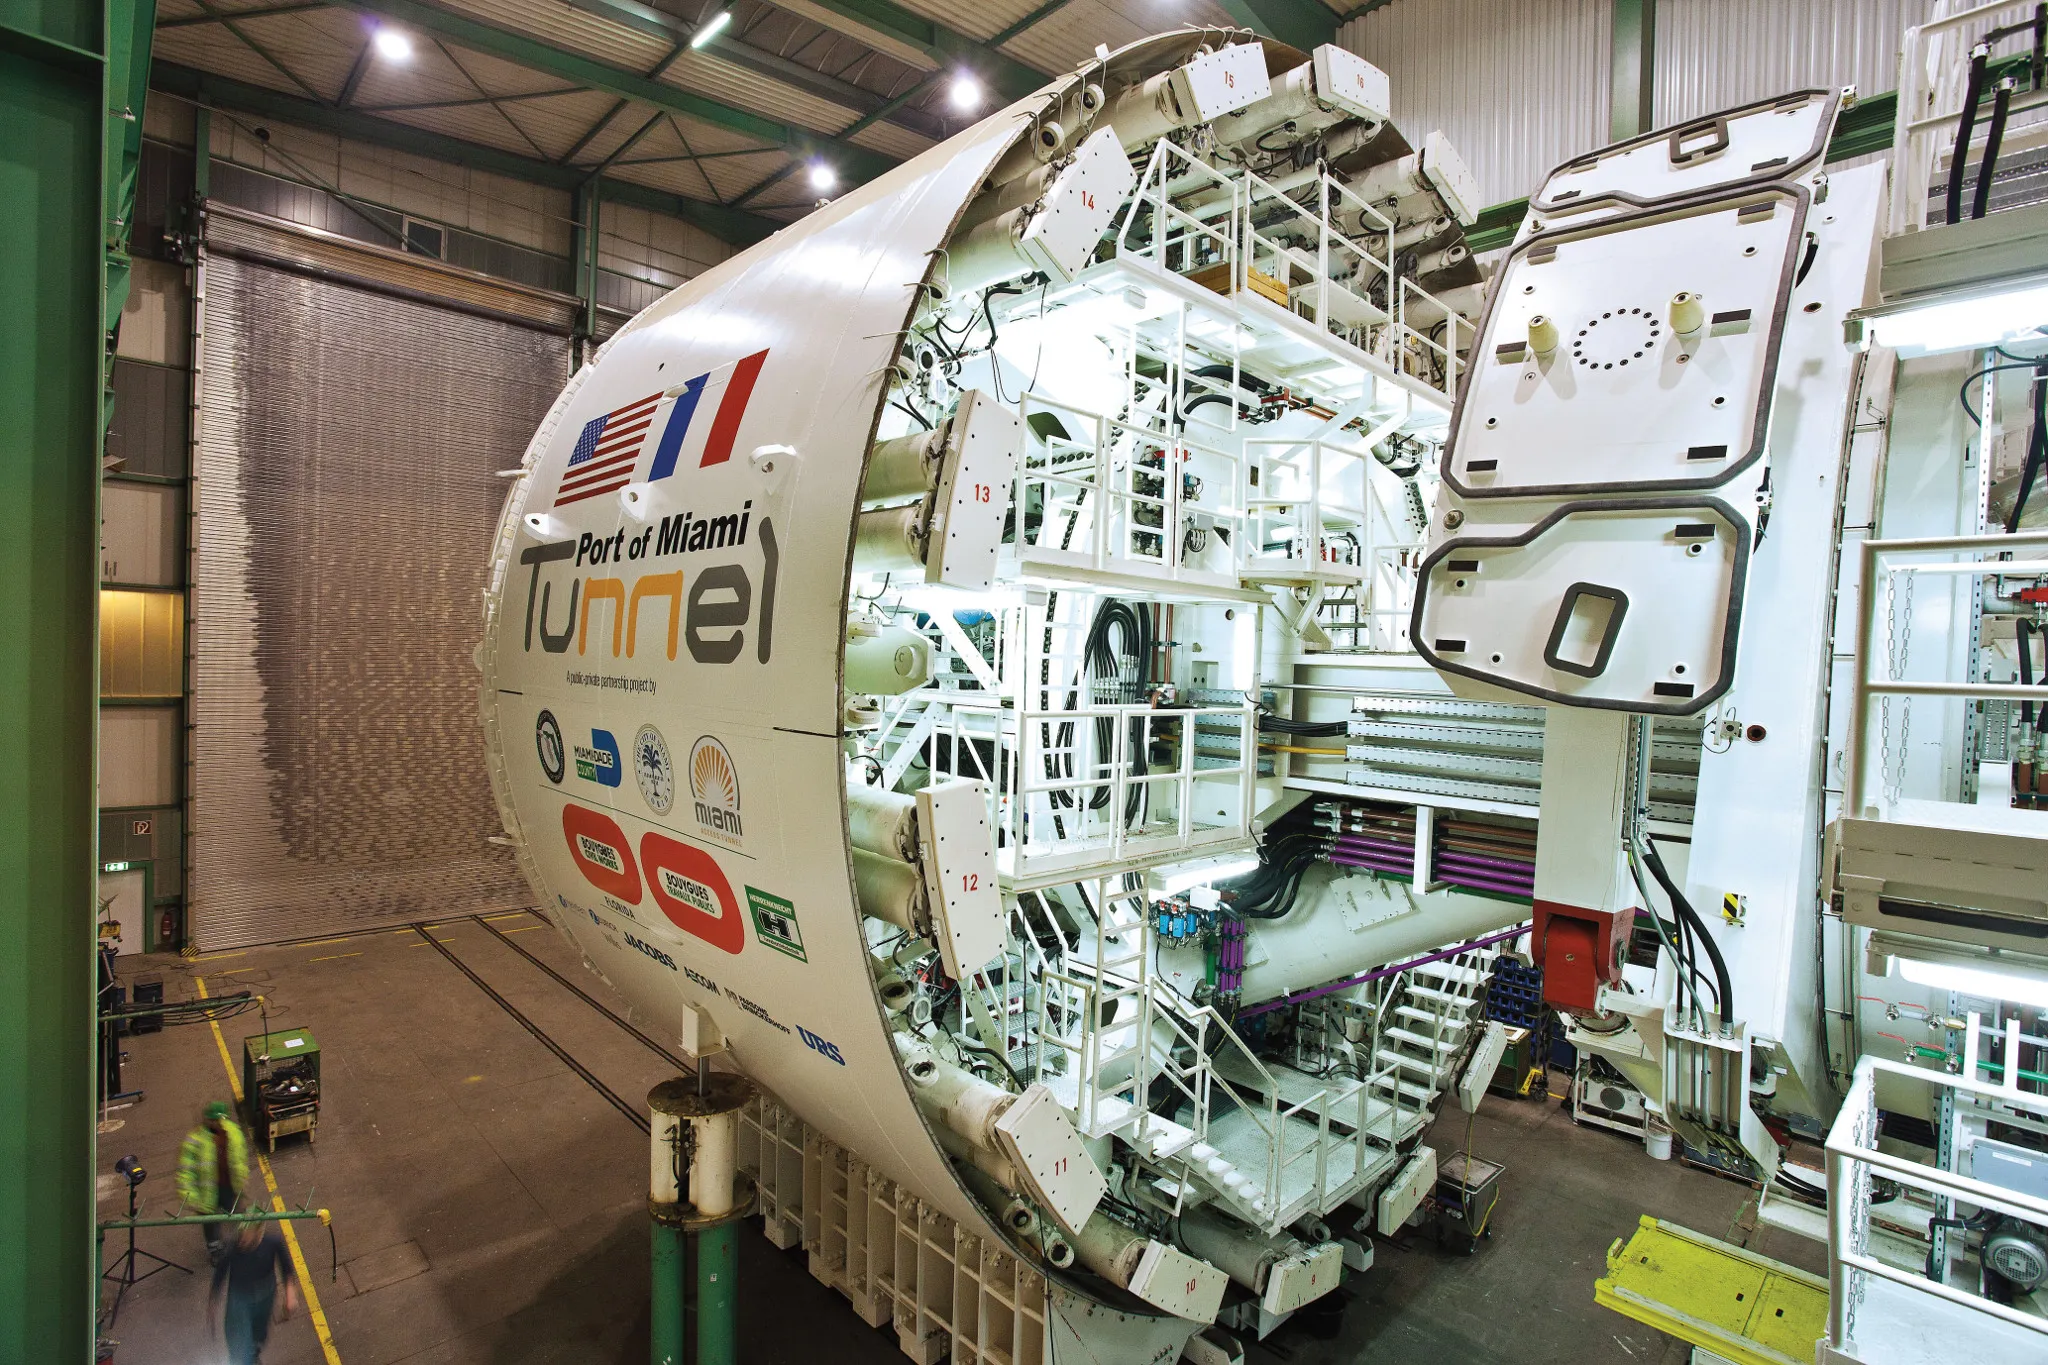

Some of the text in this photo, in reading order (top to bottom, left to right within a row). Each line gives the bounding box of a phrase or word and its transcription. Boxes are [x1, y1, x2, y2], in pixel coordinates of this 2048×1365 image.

[1224, 71, 1234, 88] 15
[1356, 74, 1364, 89] 16
[1082, 190, 1095, 210] 14
[975, 483, 990, 503] 13
[576, 500, 753, 567] Port of Miami
[520, 516, 779, 665] Tunnel
[566, 670, 656, 696] A public-private partnership project by
[581, 836, 616, 860] BOUYGUES
[666, 872, 709, 901] BOUYGUES
[963, 873, 978, 892] 12
[604, 896, 636, 920] FLORIDA
[624, 931, 678, 971] JACOBS
[684, 966, 721, 996] AECOM
[795, 1024, 846, 1066] URS
[1055, 1157, 1067, 1176] 11
[1186, 1278, 1196, 1295] 10
[1311, 1274, 1316, 1285] 9
